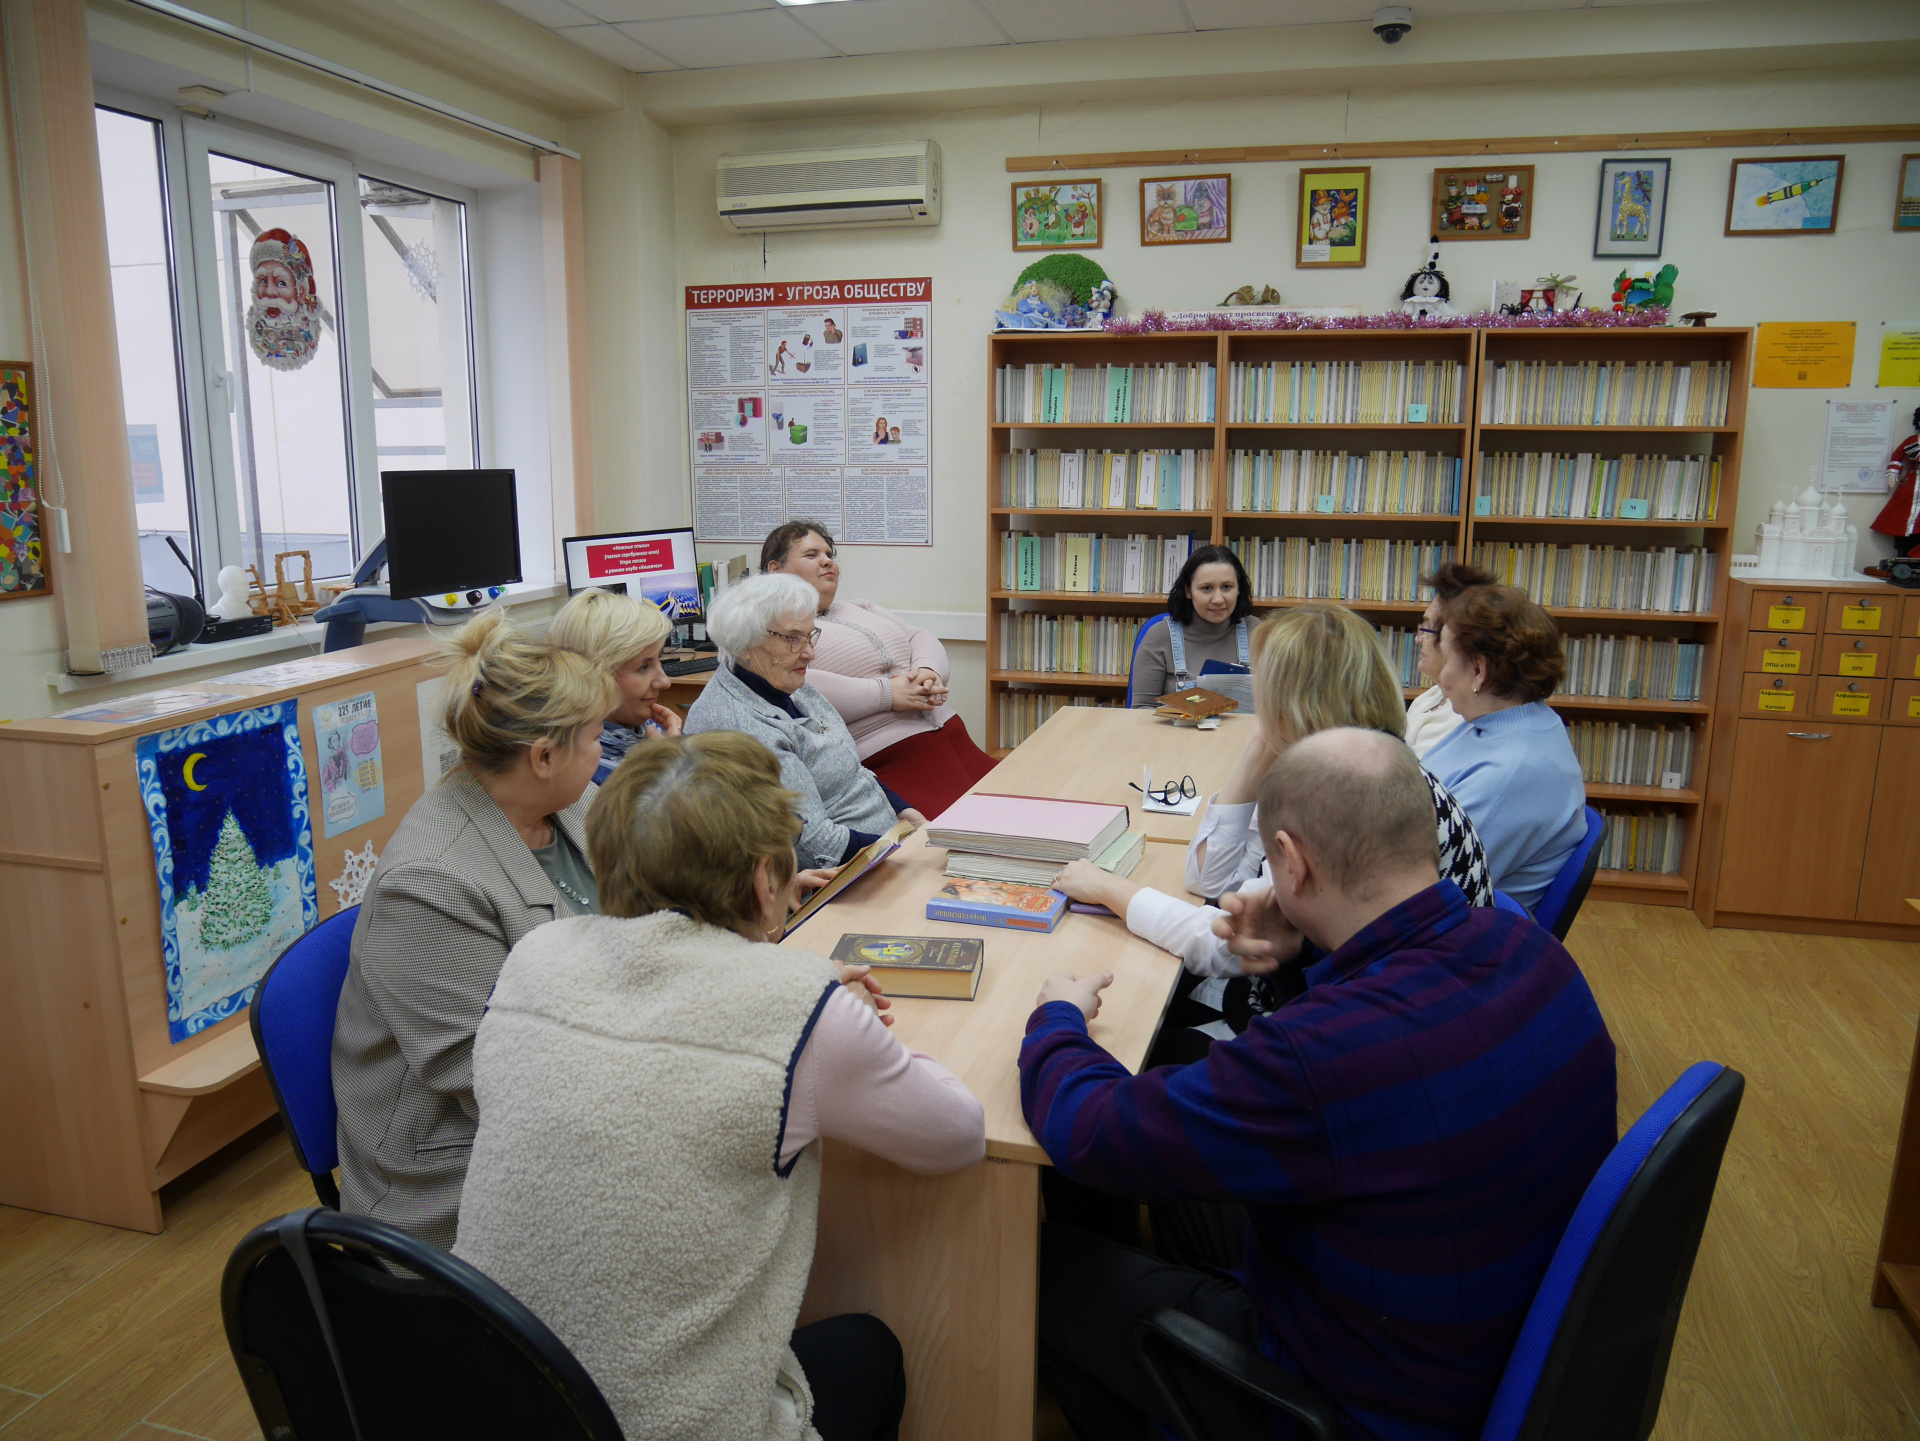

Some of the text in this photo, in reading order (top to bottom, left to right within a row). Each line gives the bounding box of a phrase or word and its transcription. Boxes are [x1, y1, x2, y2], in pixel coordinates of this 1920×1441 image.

[692, 287, 774, 304] ТЕРРОРИЗМ
[786, 285, 840, 301] УГРОЗА
[844, 282, 925, 300] ОБЩЕСТВУ
[338, 705, 349, 717] 225
[352, 699, 371, 713] ЛЕТИЕ
